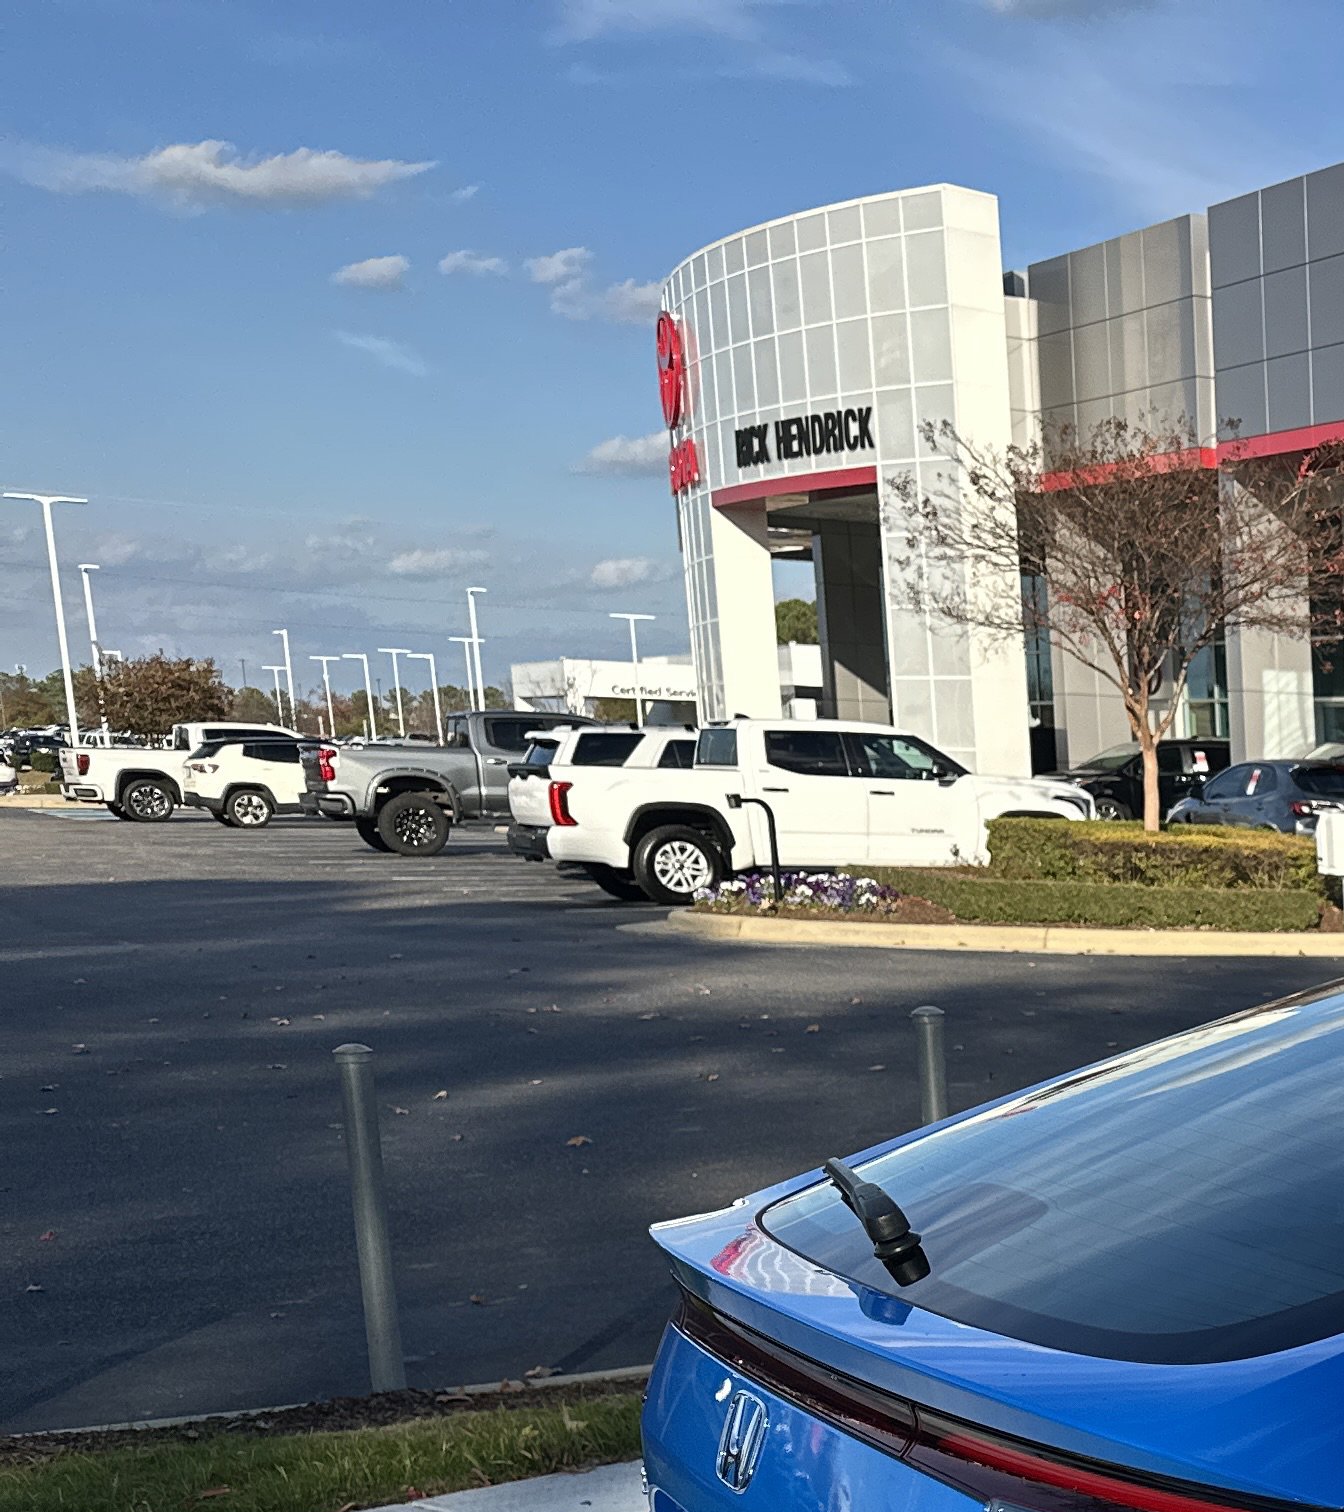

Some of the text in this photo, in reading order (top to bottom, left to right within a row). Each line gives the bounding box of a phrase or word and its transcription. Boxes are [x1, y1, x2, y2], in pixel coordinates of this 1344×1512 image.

[735, 423, 771, 468] RICK
[775, 407, 875, 461] HENDRICK
[611, 685, 662, 697] Certfied
